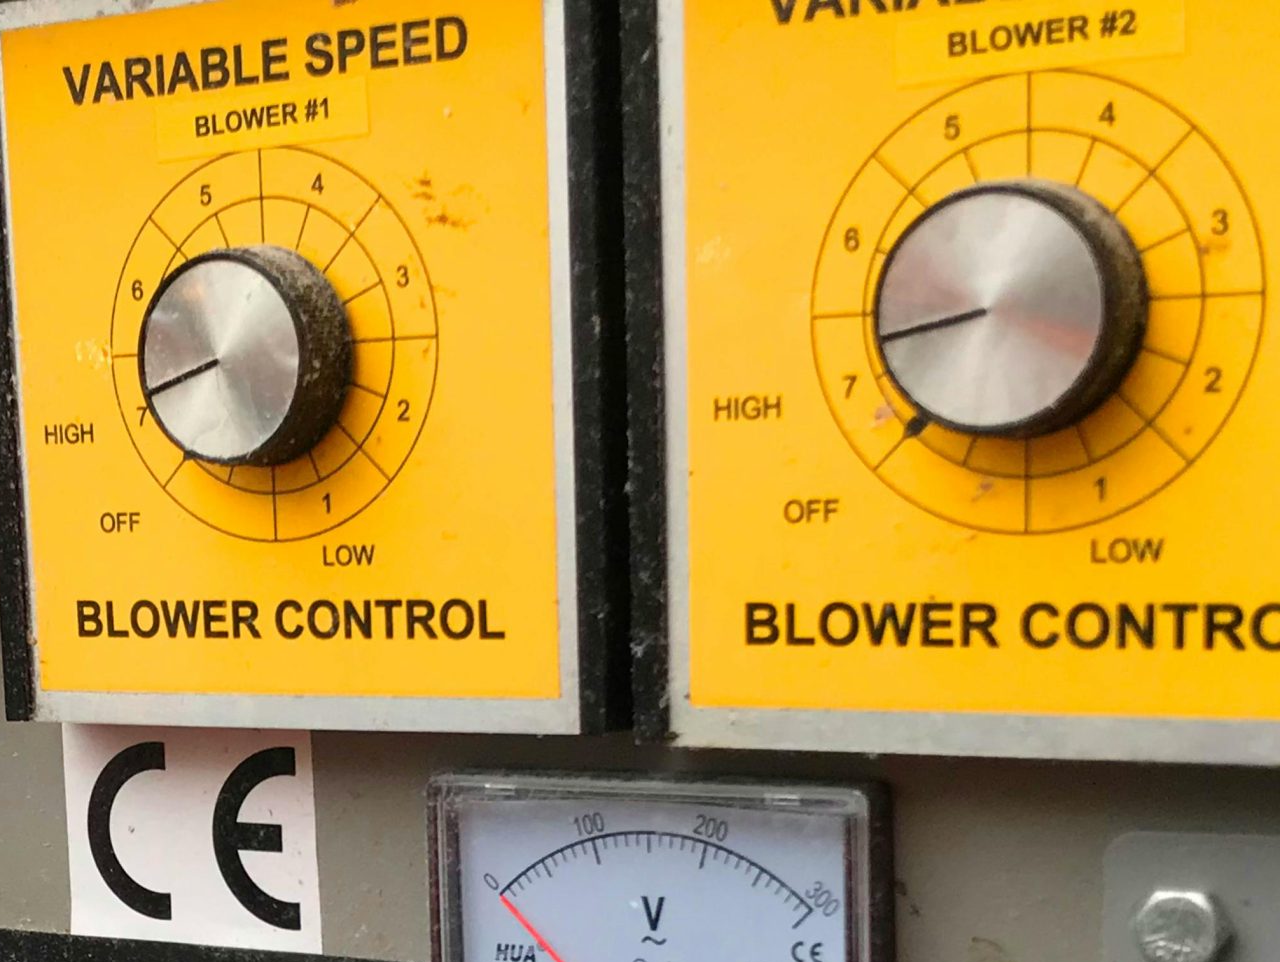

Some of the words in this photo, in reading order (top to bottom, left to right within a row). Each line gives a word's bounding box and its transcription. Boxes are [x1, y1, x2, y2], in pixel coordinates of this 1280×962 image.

[948, 16, 1089, 57] BLOWER
[1100, 10, 1136, 37] #2
[63, 38, 289, 106] VARIABLE
[305, 16, 467, 76] SPEED
[195, 103, 297, 137] BLOWER
[304, 98, 329, 123] #1
[1098, 101, 1116, 126] 4
[944, 115, 961, 141] 5
[199, 184, 213, 207] 5
[311, 172, 325, 195] 4
[1211, 208, 1230, 236] 3
[843, 226, 860, 252] 6
[396, 265, 410, 288] 3
[131, 279, 144, 302] 6
[843, 374, 858, 399] 7
[1204, 366, 1223, 394] 2
[136, 405, 149, 427] 7
[397, 399, 410, 422] 2
[713, 395, 781, 421] HIGH
[44, 422, 94, 444] HIGH
[1094, 476, 1107, 500] 1
[322, 493, 331, 514] 1
[783, 498, 839, 524] OFF
[100, 511, 141, 534] OFF
[322, 544, 375, 567] LOW
[1091, 538, 1164, 564] LOW
[76, 600, 262, 639] BLOWER
[274, 599, 506, 641] CONTROL
[745, 602, 999, 648] BLOWER
[1022, 603, 1280, 652] CONTRO
[87, 741, 301, 931] CE
[574, 812, 606, 836] 100
[693, 814, 730, 842] 200
[483, 872, 500, 891] 0
[804, 880, 840, 918] 300
[641, 895, 666, 932] V
[495, 943, 537, 962] HUA
